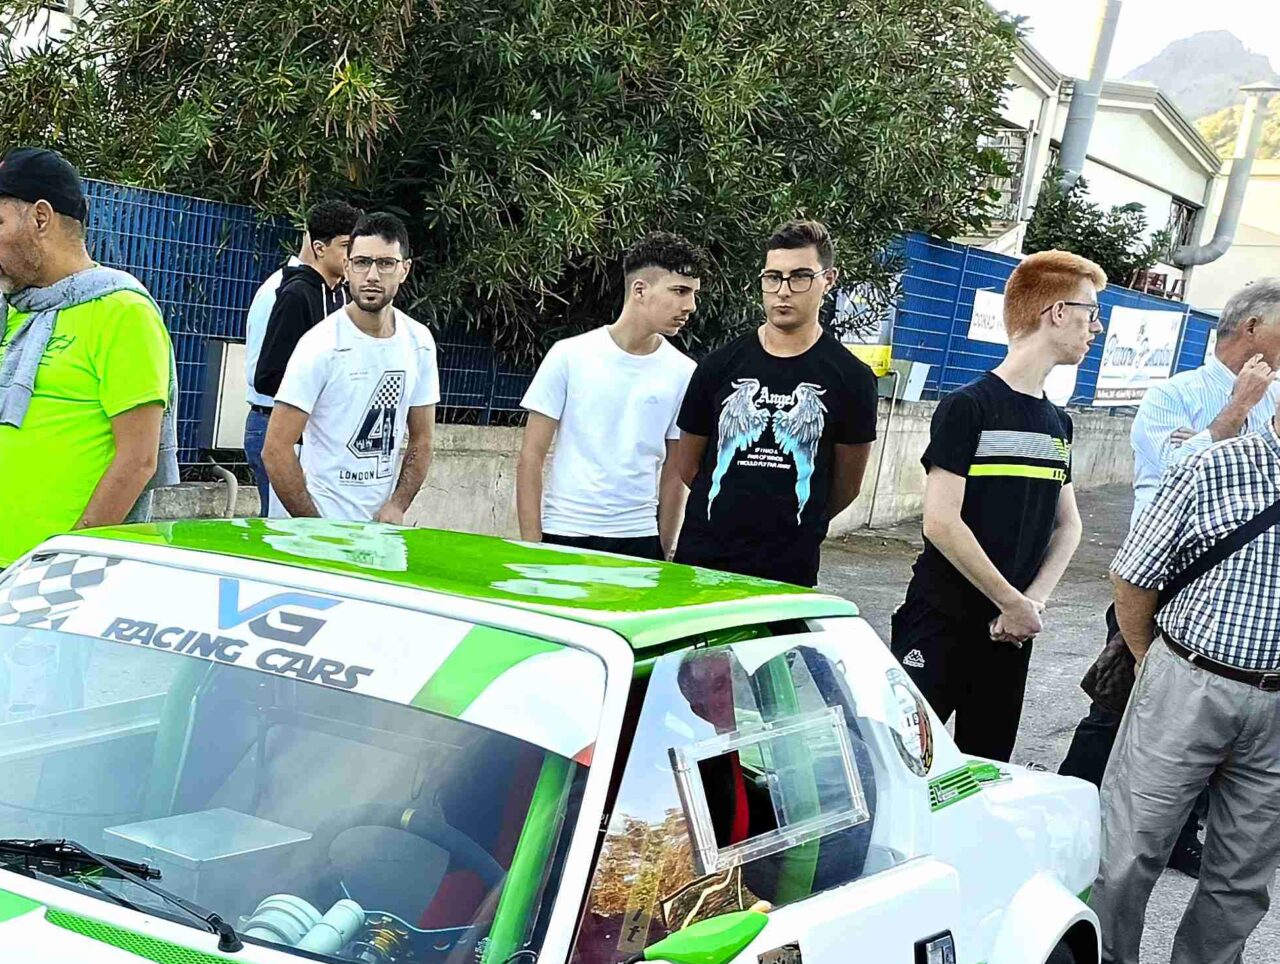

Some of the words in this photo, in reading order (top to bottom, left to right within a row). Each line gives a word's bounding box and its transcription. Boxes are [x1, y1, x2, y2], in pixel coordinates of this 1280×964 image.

[754, 386, 795, 409] Angel
[339, 470, 375, 481] LONDON
[218, 577, 343, 647] VG
[100, 616, 246, 663] RACING
[255, 647, 375, 691] CARS
